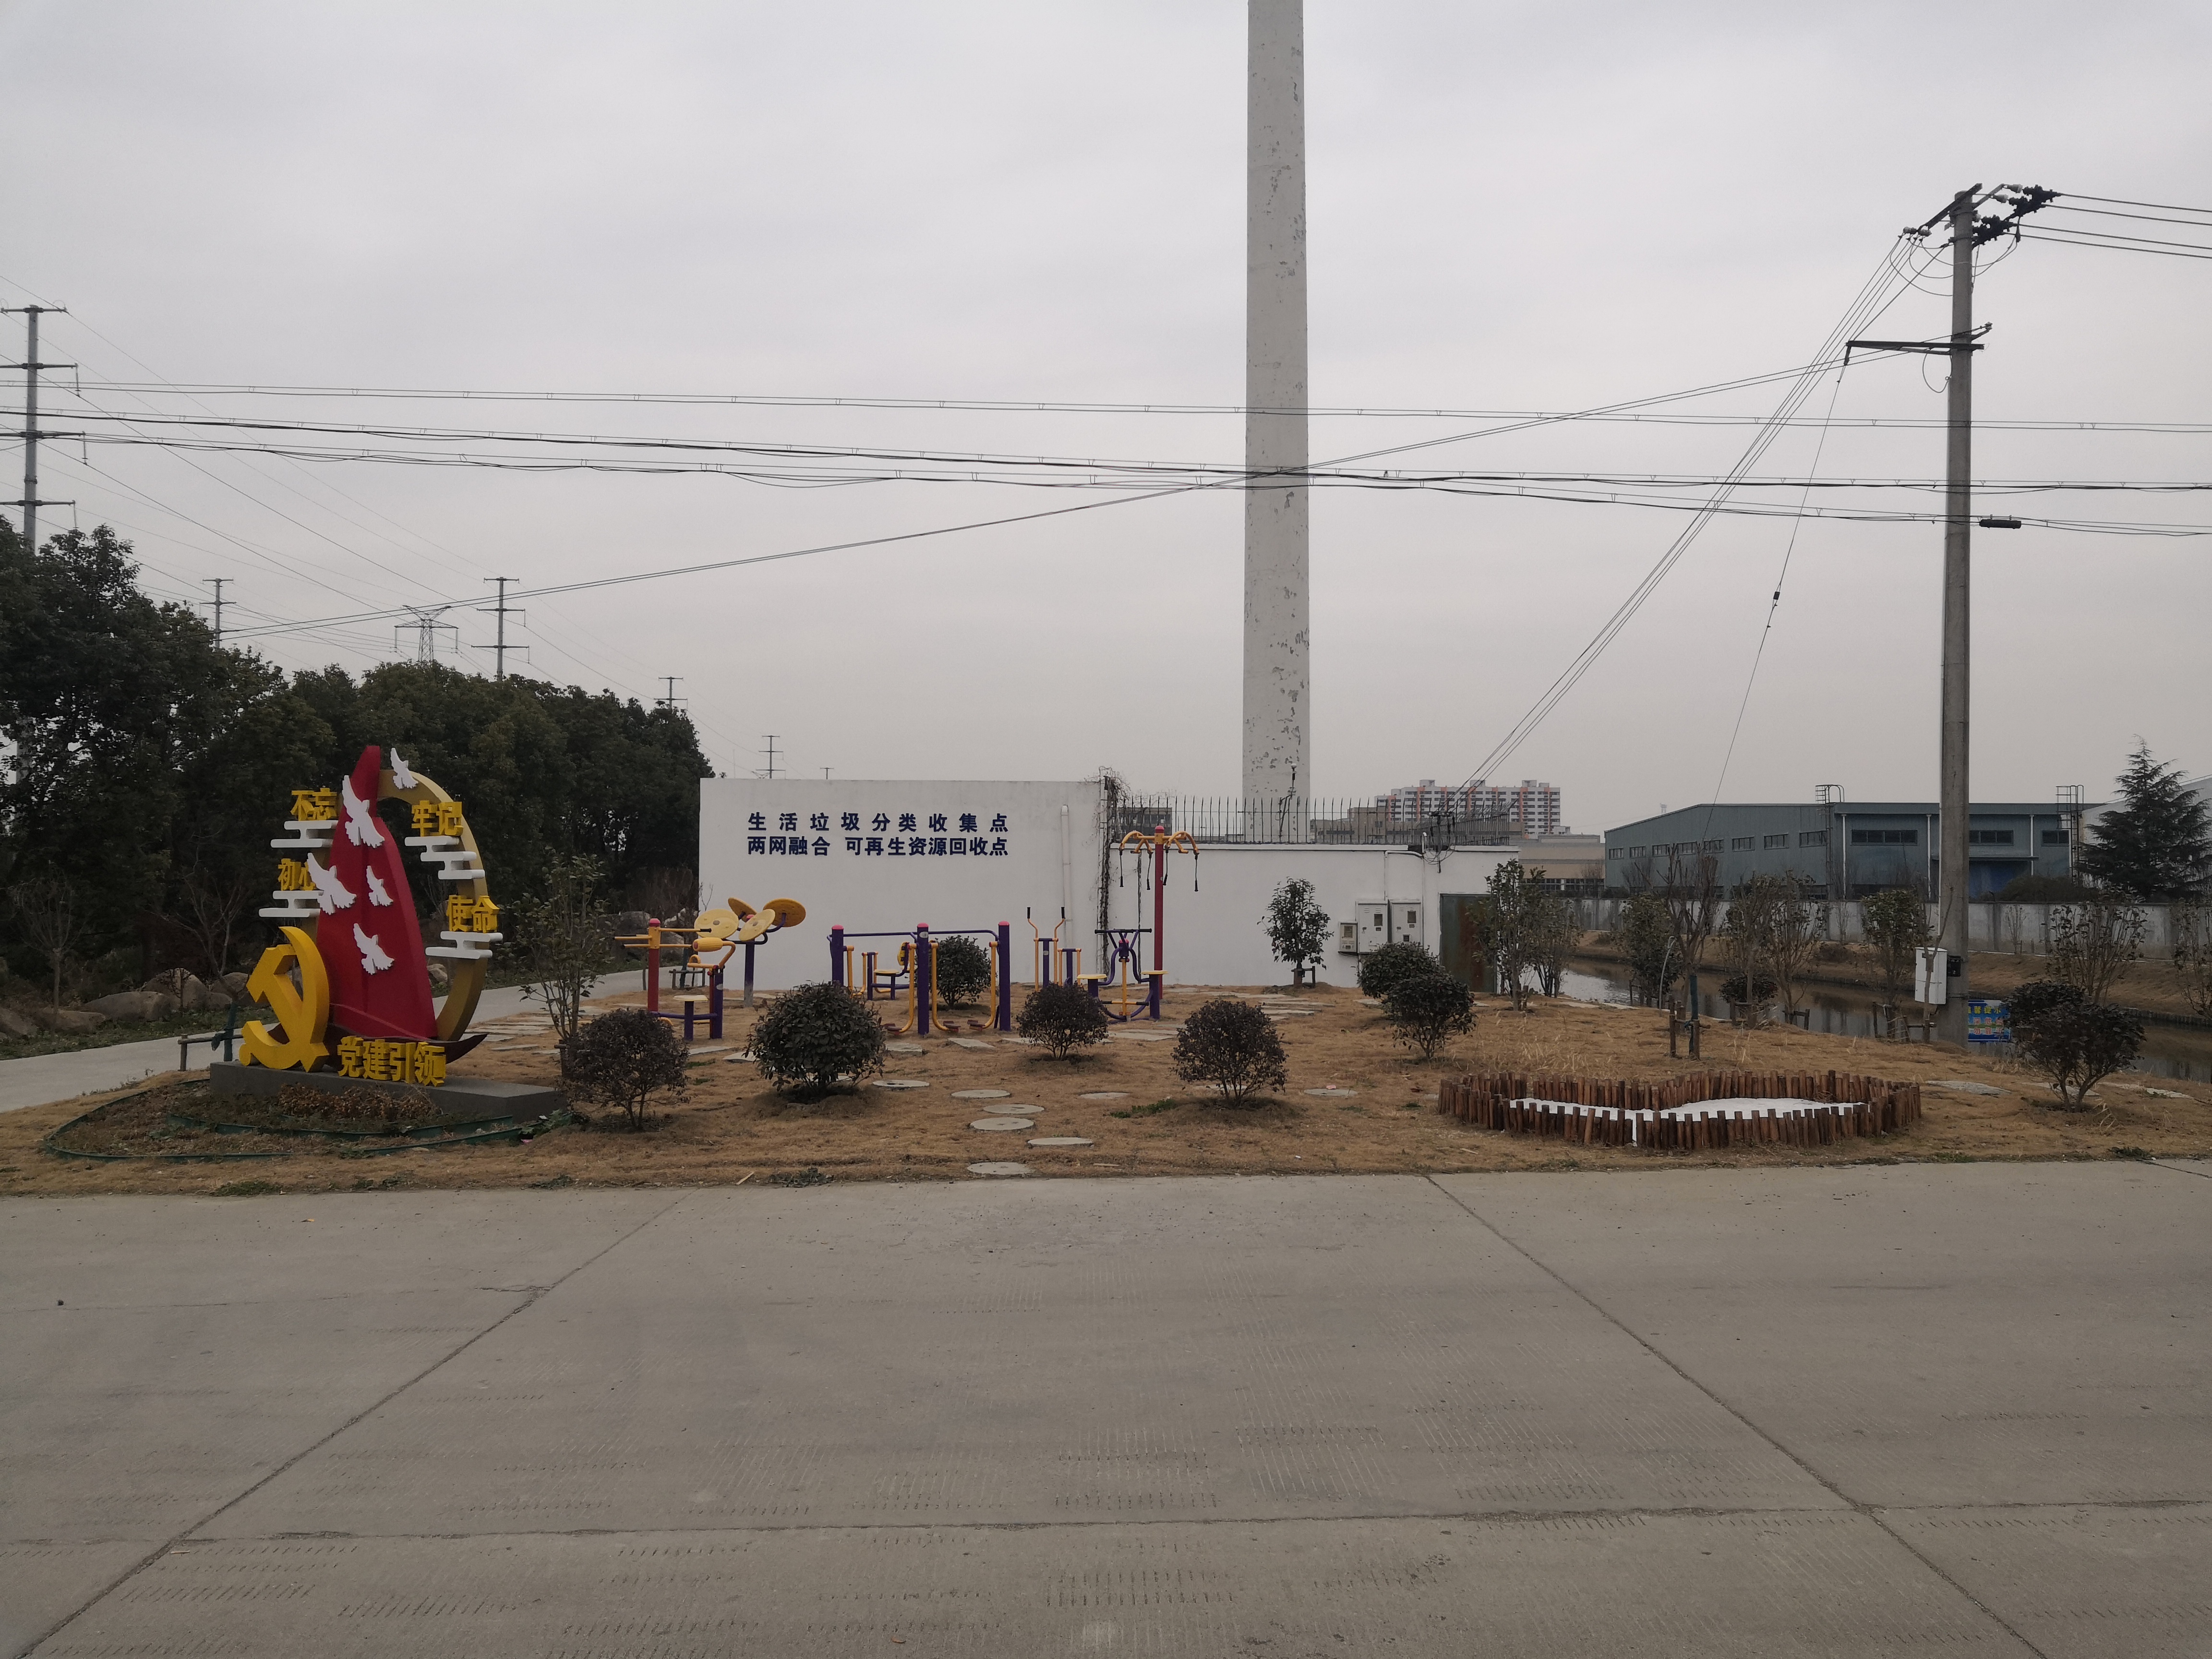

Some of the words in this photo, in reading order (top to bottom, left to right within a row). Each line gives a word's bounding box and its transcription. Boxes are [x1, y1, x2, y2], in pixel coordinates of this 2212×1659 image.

[291, 788, 337, 821] 不忘
[411, 800, 464, 837] 牢记
[747, 812, 1009, 832] 生活垃圾分类收集点
[747, 836, 830, 856] 两网融合
[845, 836, 1009, 856] 可再生资源回收点
[446, 894, 500, 933] 使命
[337, 1035, 447, 1087] 党建引领
